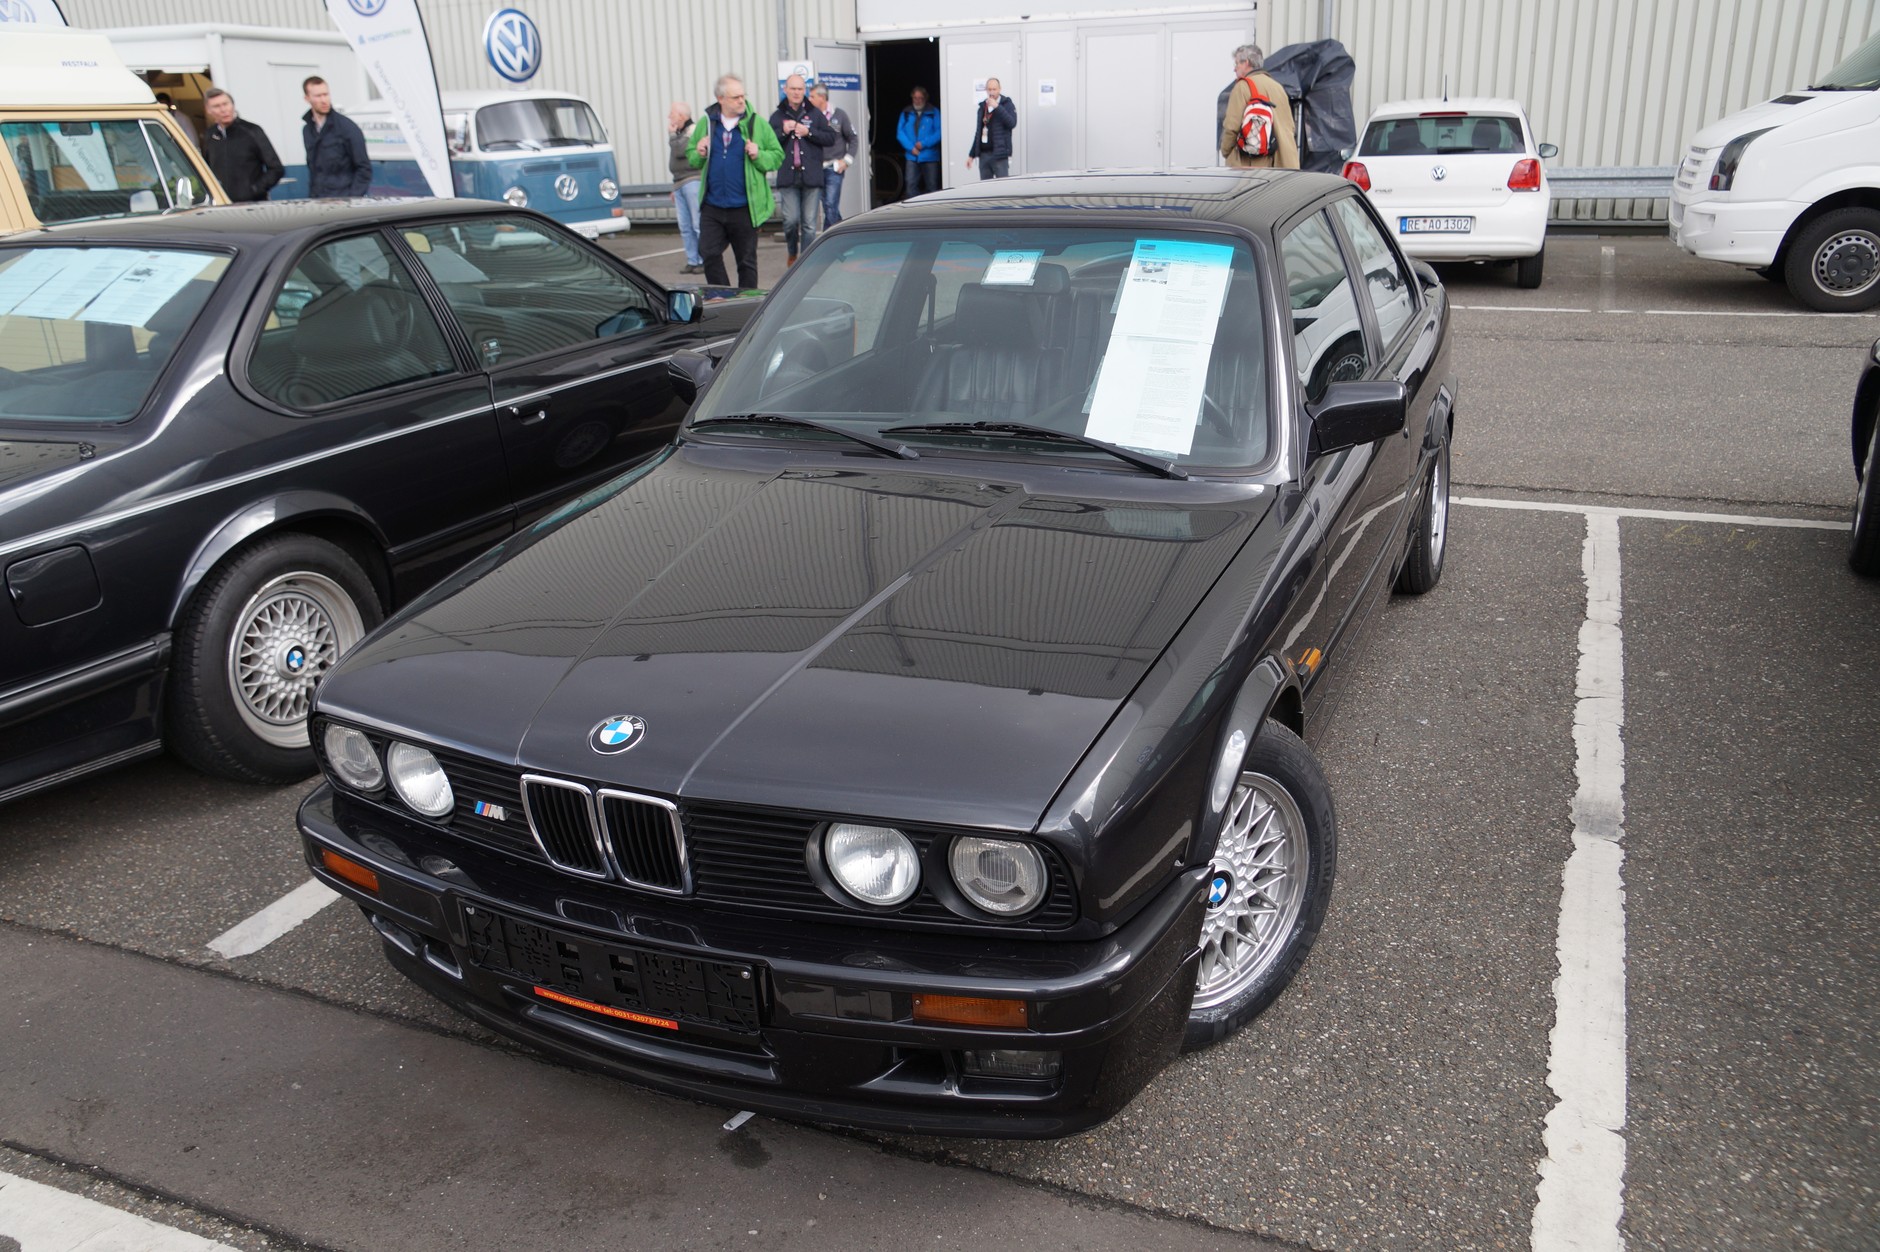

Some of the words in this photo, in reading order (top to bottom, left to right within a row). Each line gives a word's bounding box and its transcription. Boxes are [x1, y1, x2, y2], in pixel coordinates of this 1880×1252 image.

[491, 11, 539, 79] VW
[1407, 218, 1420, 231] RE
[1428, 218, 1441, 231] AO
[1445, 218, 1469, 231] 1302
